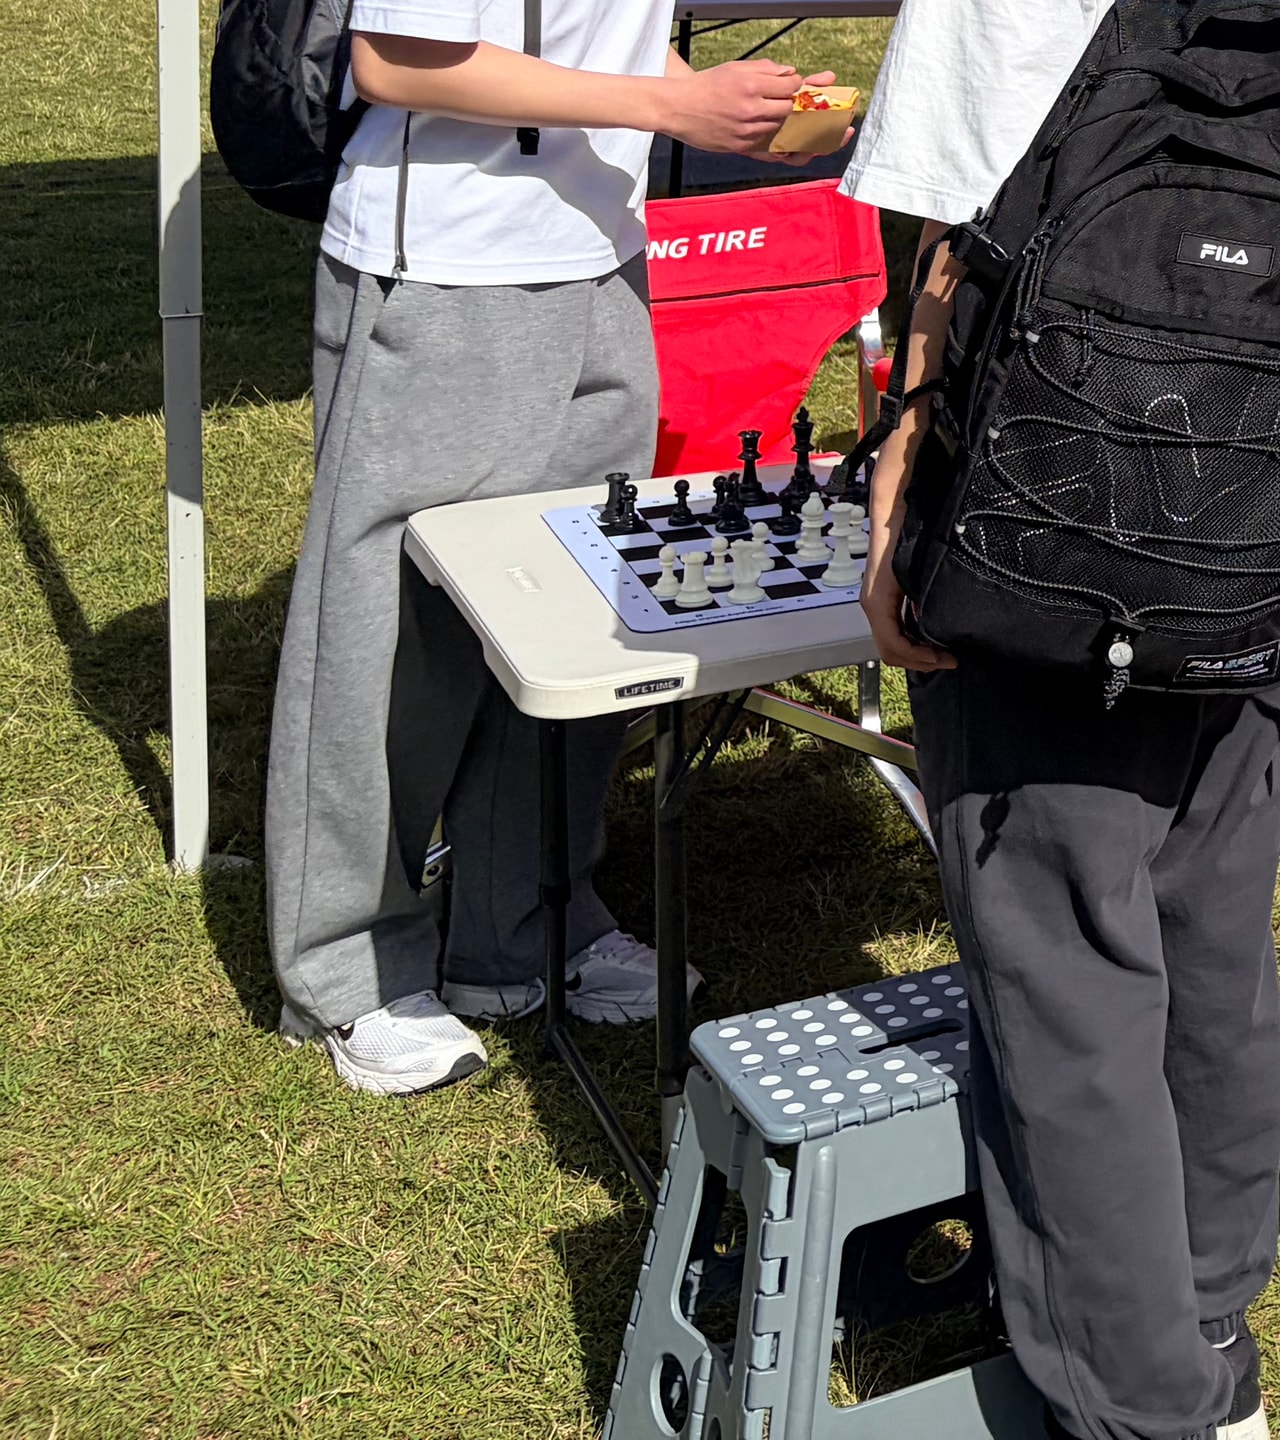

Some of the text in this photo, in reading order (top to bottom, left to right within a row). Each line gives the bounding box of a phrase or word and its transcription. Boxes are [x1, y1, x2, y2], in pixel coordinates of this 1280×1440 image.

[698, 226, 767, 255] TIRE
[1199, 242, 1249, 266] FILA
[624, 679, 676, 697] LIFETIME
